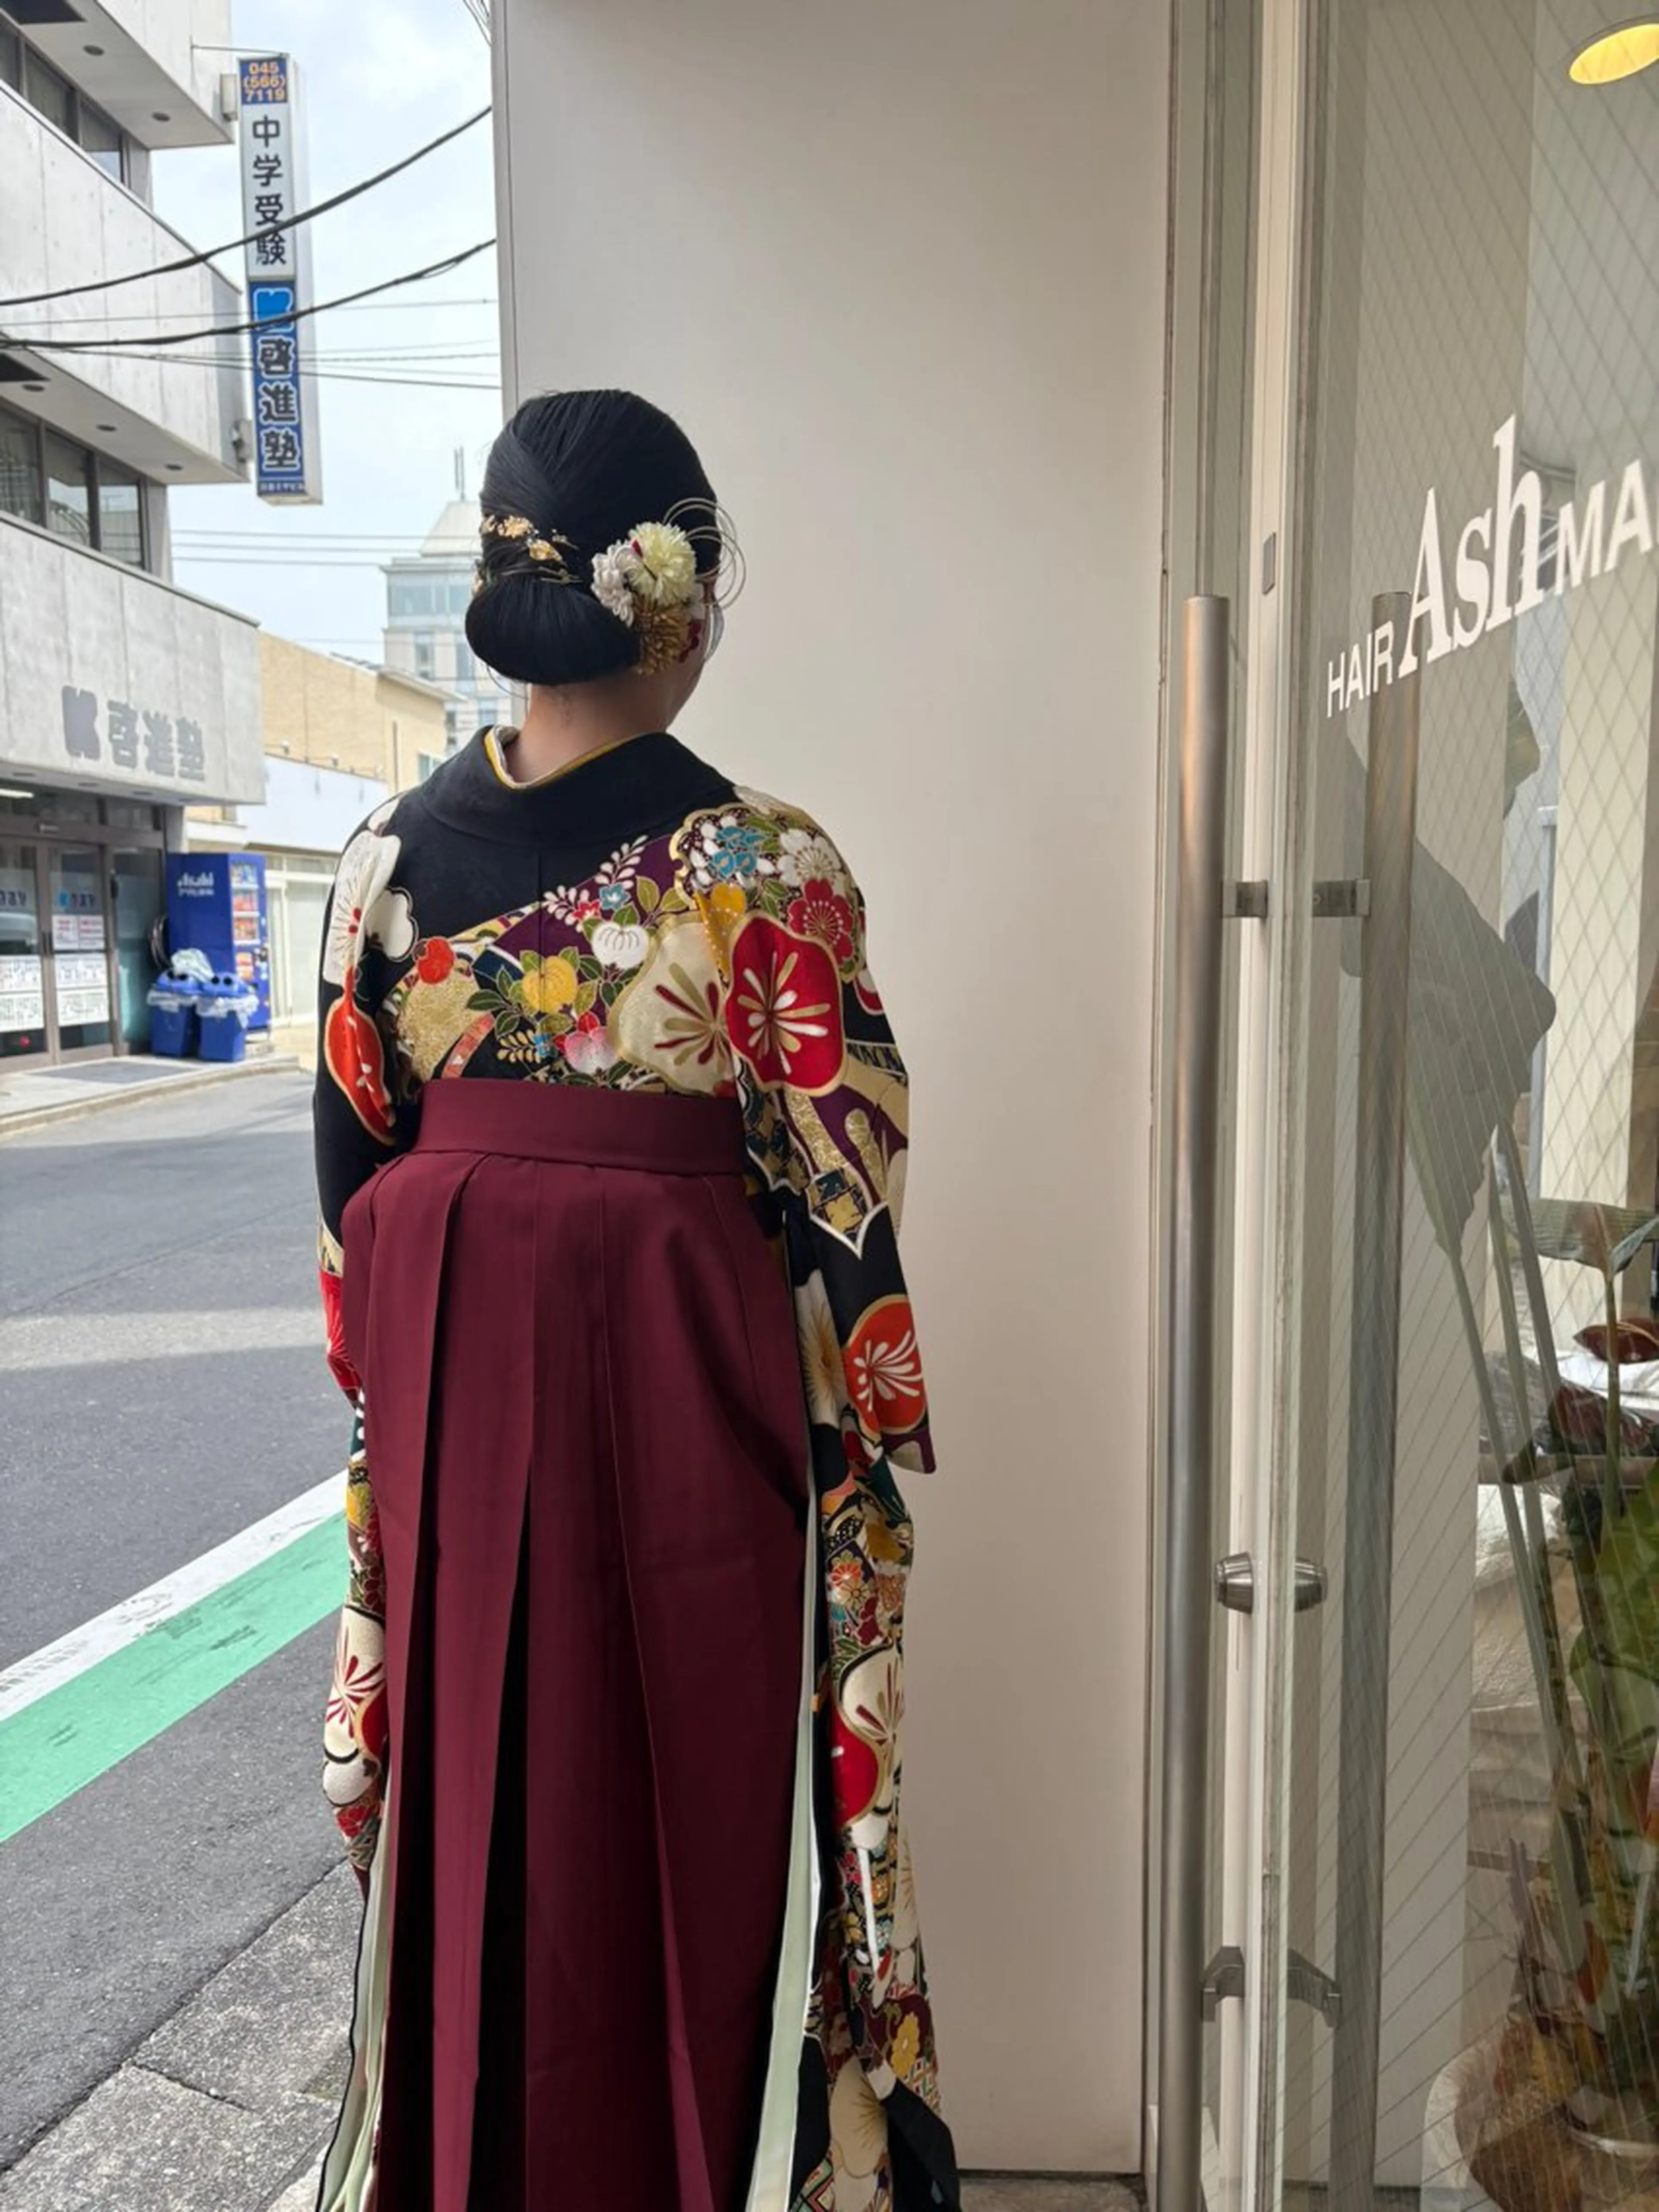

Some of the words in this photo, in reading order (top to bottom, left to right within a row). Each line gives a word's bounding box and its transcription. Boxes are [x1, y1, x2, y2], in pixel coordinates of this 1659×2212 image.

[245, 88, 284, 102] 7119
[249, 62, 279, 75] 045
[252, 115, 286, 265] 中学受験
[259, 337, 299, 470] 啓進塾
[1327, 620, 1394, 718] HAIR
[1398, 413, 1545, 679] Ash
[1554, 459, 1659, 597] MA
